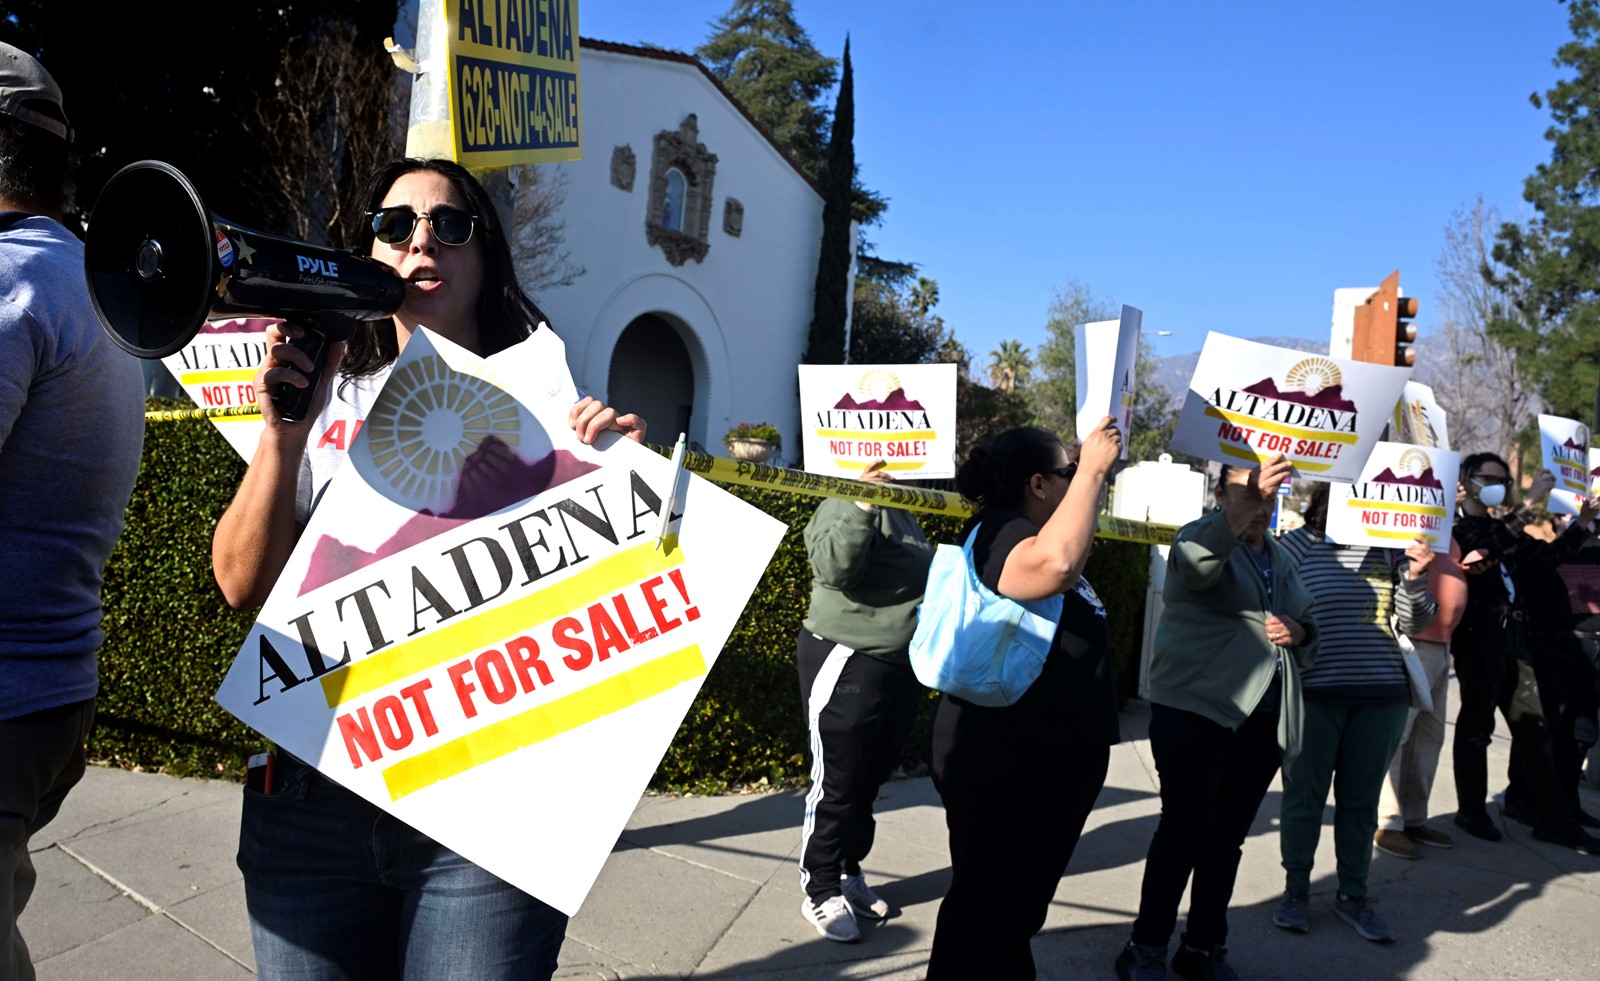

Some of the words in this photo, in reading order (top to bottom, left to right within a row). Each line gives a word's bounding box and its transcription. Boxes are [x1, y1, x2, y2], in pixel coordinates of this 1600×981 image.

[458, 0, 574, 62] ALTADENA
[462, 64, 578, 146] 626-NOT-4-SALE
[296, 255, 339, 277] PYLE
[177, 341, 268, 370] ALTAD
[202, 386, 231, 406] NOT
[237, 385, 257, 406] FO
[1204, 387, 1359, 433] ALTADENA
[815, 410, 932, 430] ALTADENA
[830, 440, 853, 456] NOT
[858, 442, 882, 457] FOR
[887, 441, 927, 457] SALE!
[1218, 422, 1256, 445] NOT
[1257, 432, 1295, 454] FOR
[1294, 439, 1343, 460] SALE!
[1346, 483, 1446, 507] ALTADENA
[1362, 511, 1389, 525] NOT
[1394, 513, 1417, 528] FOR
[1420, 514, 1441, 531] SALE!
[253, 469, 683, 706] ALTADENA
[336, 677, 440, 770] NOT
[447, 635, 555, 719] FOR
[551, 569, 702, 672] SALE!
